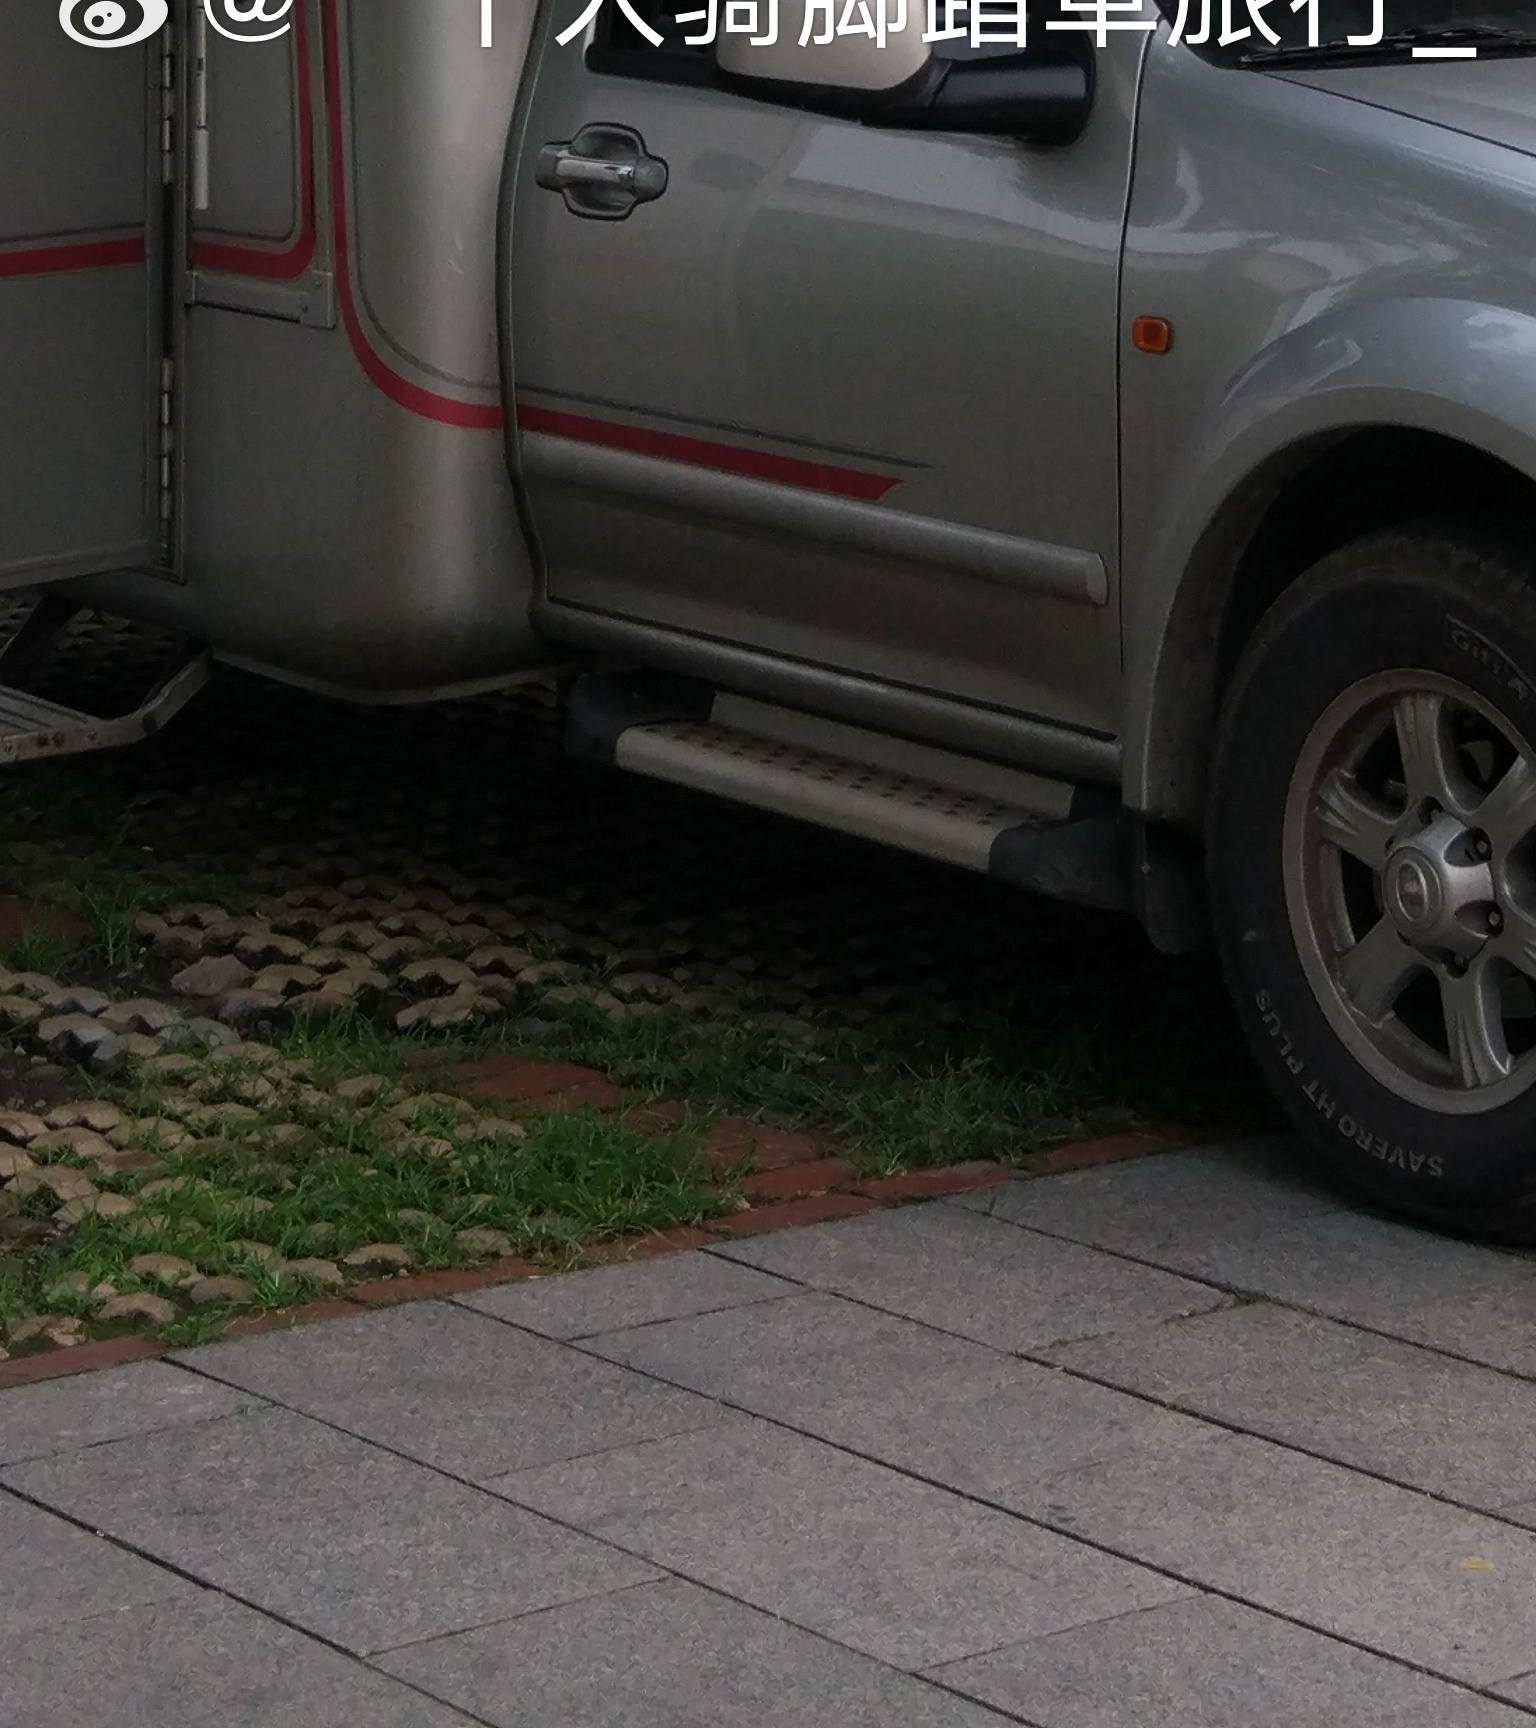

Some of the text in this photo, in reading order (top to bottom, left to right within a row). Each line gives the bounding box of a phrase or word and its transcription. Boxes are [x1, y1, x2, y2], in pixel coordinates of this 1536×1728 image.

[1254, 988, 1443, 1178] SAVERO HT PLUS
